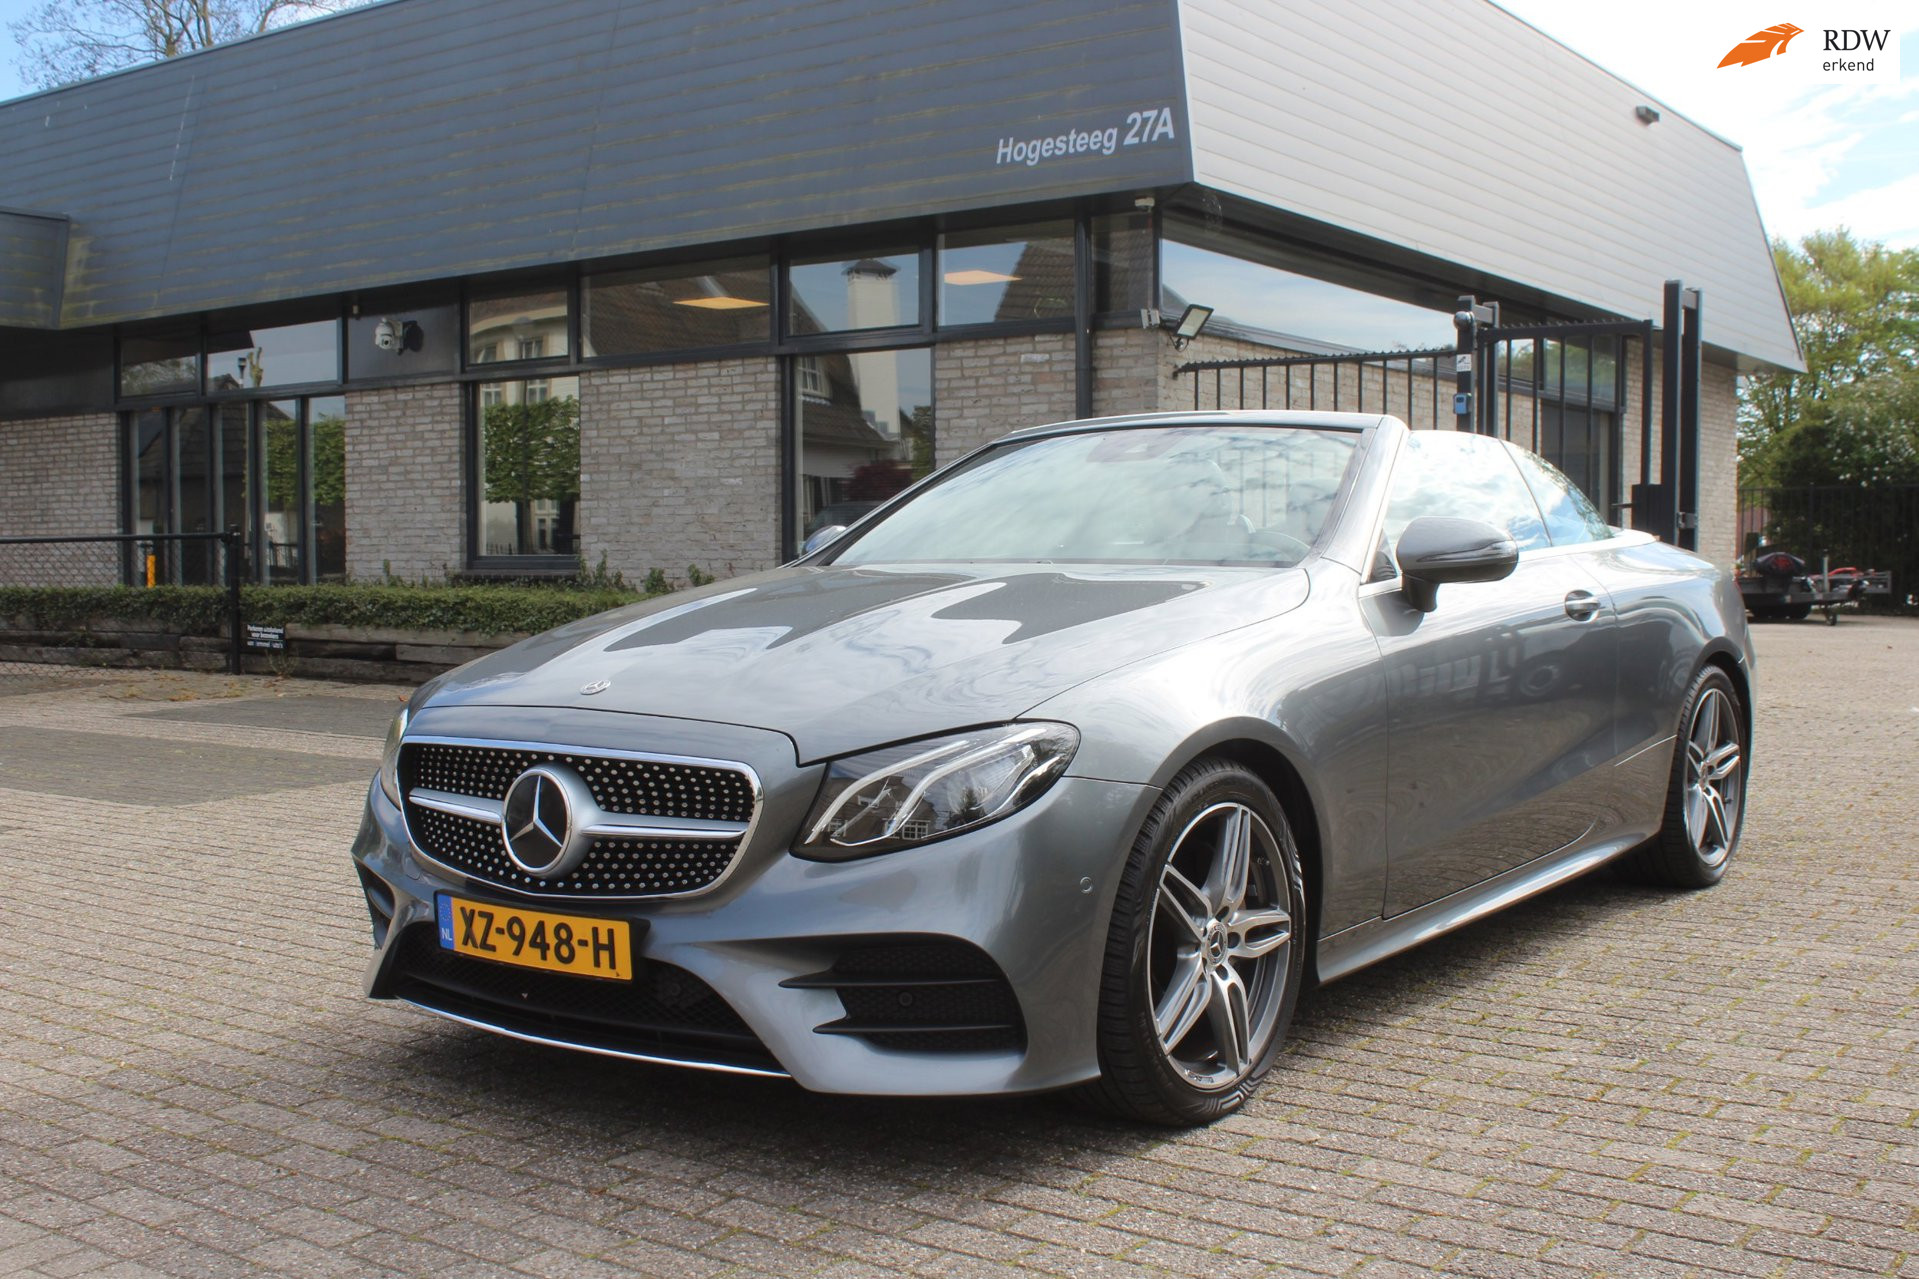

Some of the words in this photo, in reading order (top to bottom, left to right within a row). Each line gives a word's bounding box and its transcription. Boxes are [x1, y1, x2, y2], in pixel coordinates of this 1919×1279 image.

[996, 127, 1118, 166] Hogesteeg
[1123, 106, 1175, 146] 27A
[441, 927, 453, 941] NL
[460, 906, 616, 970] XZ-948-H
